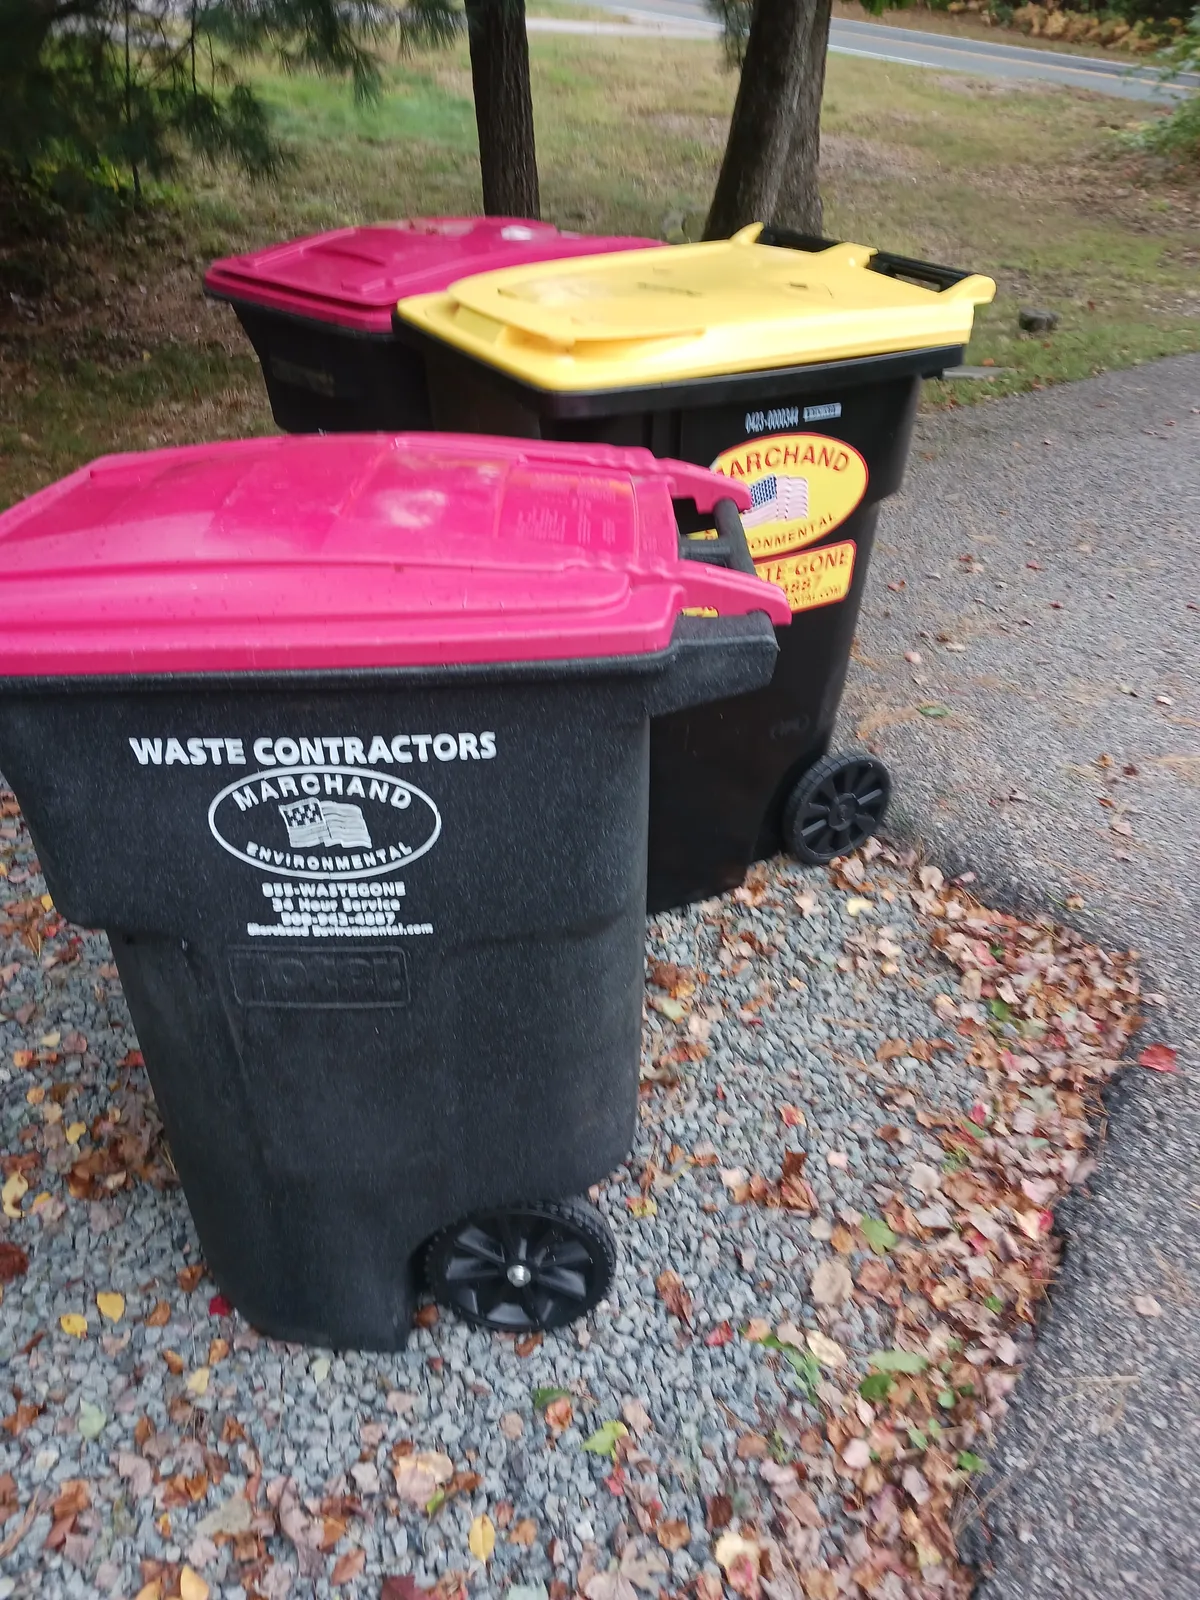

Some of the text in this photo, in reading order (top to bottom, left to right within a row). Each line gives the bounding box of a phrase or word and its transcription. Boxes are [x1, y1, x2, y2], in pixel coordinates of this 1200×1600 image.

[128, 731, 498, 766] WASTE CONTRACTORS
[231, 773, 412, 812] MARCHAND
[246, 841, 413, 871] ENVIRONMENTAL
[298, 897, 338, 912] Hour
[341, 897, 401, 912] Service
